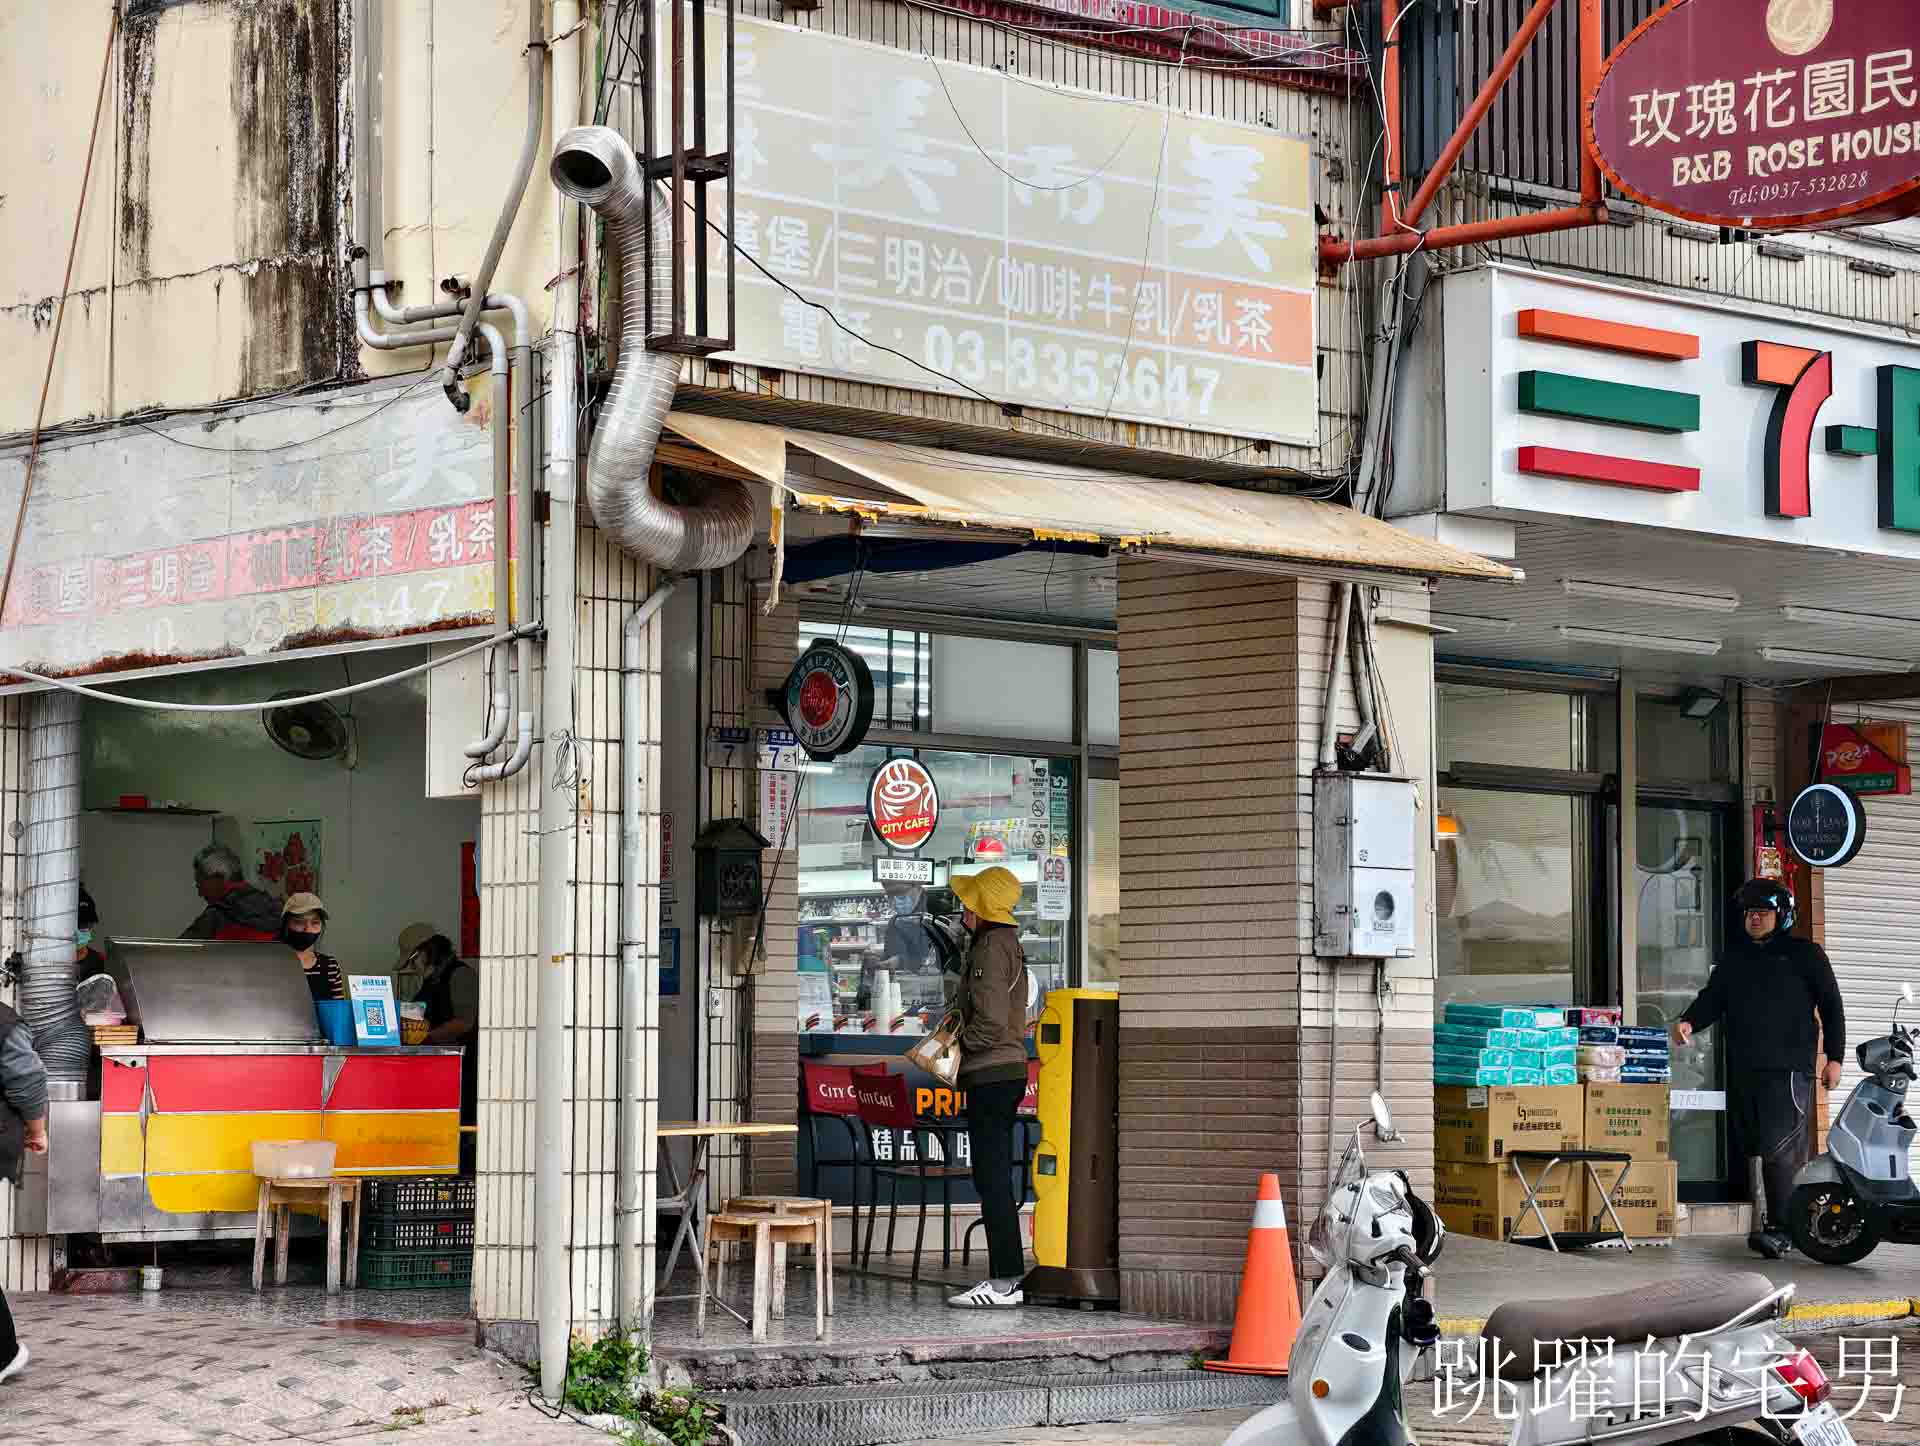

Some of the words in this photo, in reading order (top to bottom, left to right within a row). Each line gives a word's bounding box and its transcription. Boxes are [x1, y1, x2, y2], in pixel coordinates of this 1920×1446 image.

[1628, 48, 1918, 148] 玫瑰花園民
[1672, 150, 1732, 187] B&B
[1747, 135, 1825, 176] ROSE
[1728, 169, 1870, 207] Tel:0937-532828
[1741, 339, 1920, 536] 7-
[881, 821, 903, 834] CITY
[904, 817, 930, 830] CAFE
